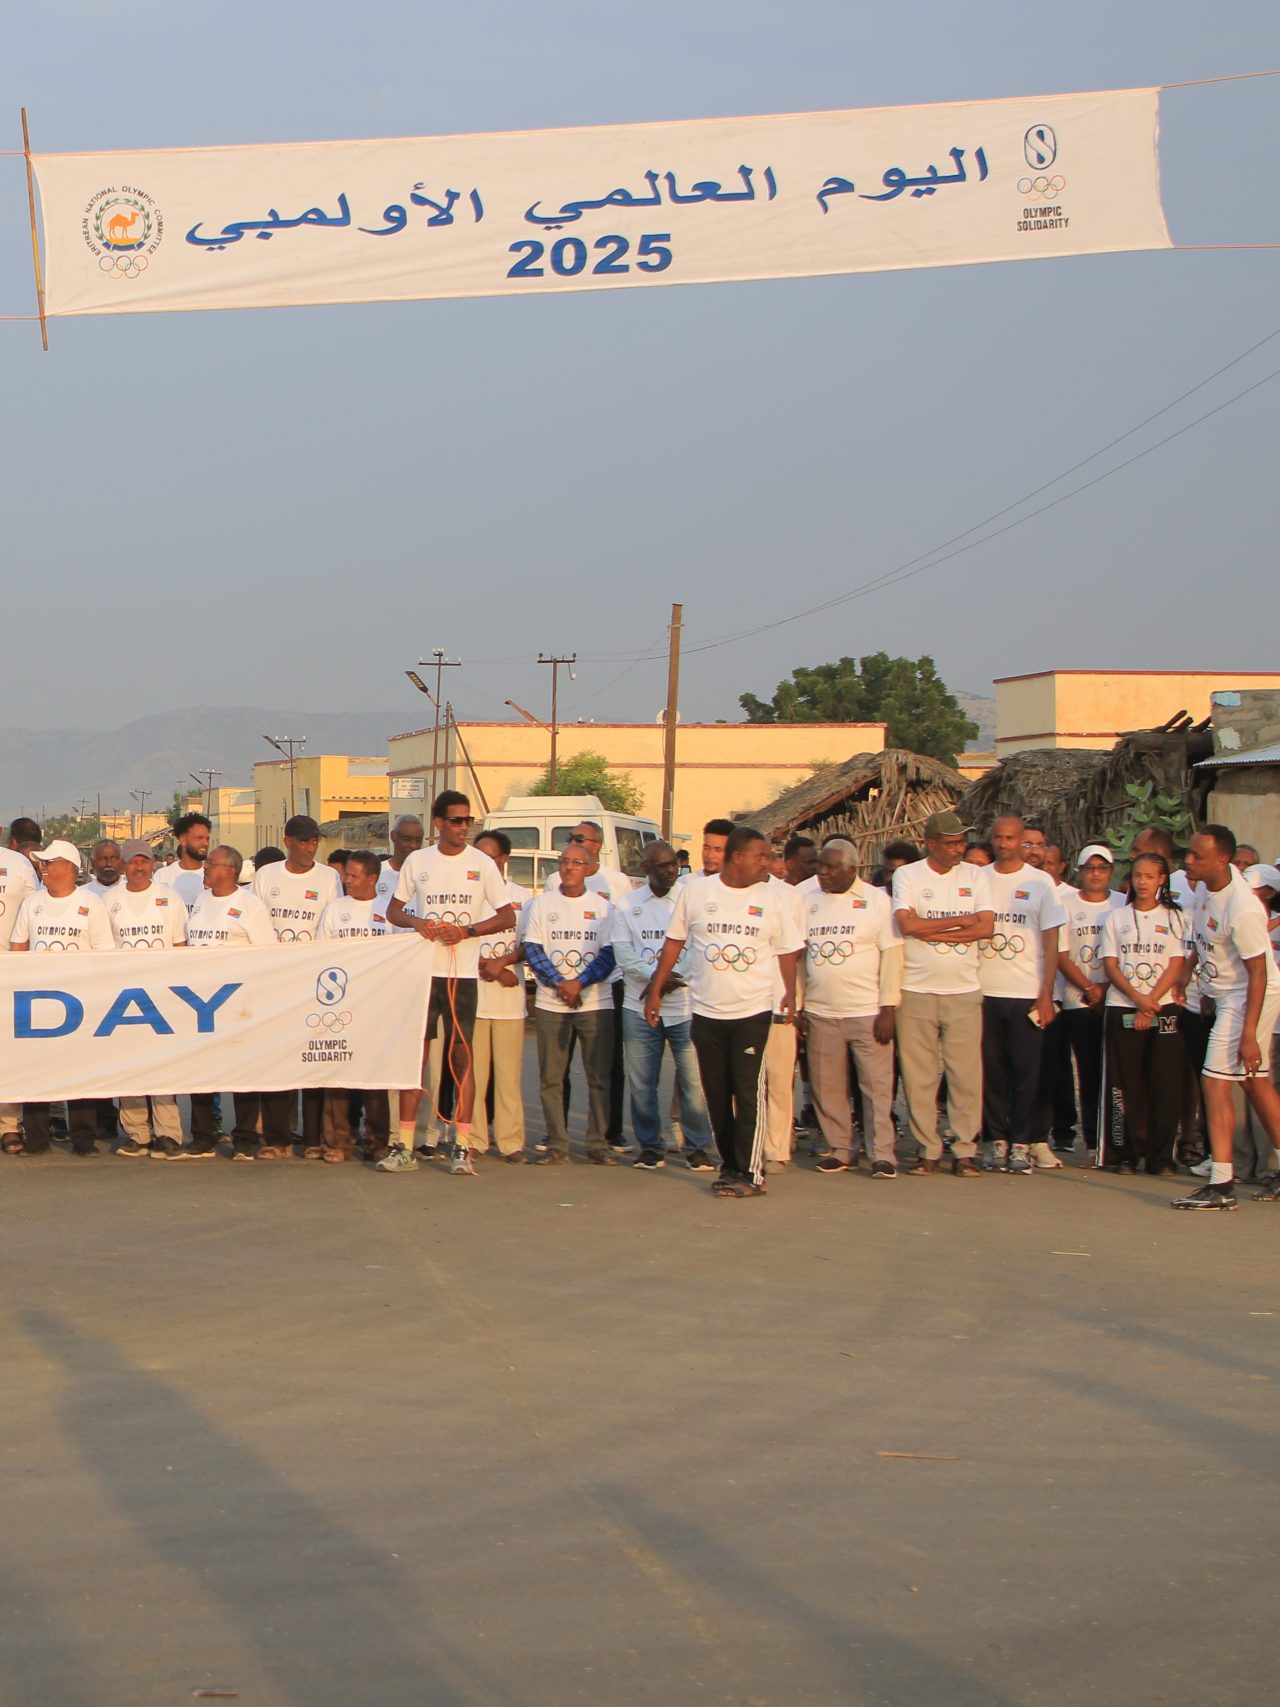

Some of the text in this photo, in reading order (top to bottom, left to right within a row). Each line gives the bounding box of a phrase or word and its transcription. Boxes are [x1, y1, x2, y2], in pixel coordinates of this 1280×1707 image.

[185, 146, 989, 251] اليوم العالمي الأولمبي
[1023, 206, 1062, 219] OLYMPIC
[82, 186, 163, 256] ERITREAN NATIONAL OLYMPIC COMMITTEE
[1017, 218, 1069, 232] SOLIDARITY
[506, 233, 673, 278] 2025
[427, 894, 472, 904] OLYMPIC DAY
[271, 908, 315, 921] OLYMPIC DAY
[1012, 914, 1026, 924] DAY
[38, 926, 66, 936] OLYMPIC
[120, 925, 163, 937] OLYMPIC DAY
[215, 930, 228, 940] DAY
[339, 927, 368, 938] OLYMPIC
[551, 930, 597, 941] OLYMPIC DAY
[642, 930, 665, 940] OLYMP
[707, 923, 759, 937] OLYMPIC DAY
[808, 925, 856, 936] OLYMPIC DAY
[13, 983, 242, 1039] DAY
[309, 1039, 347, 1050] OLYMPIC
[301, 1051, 353, 1062] SOLIDARITY
